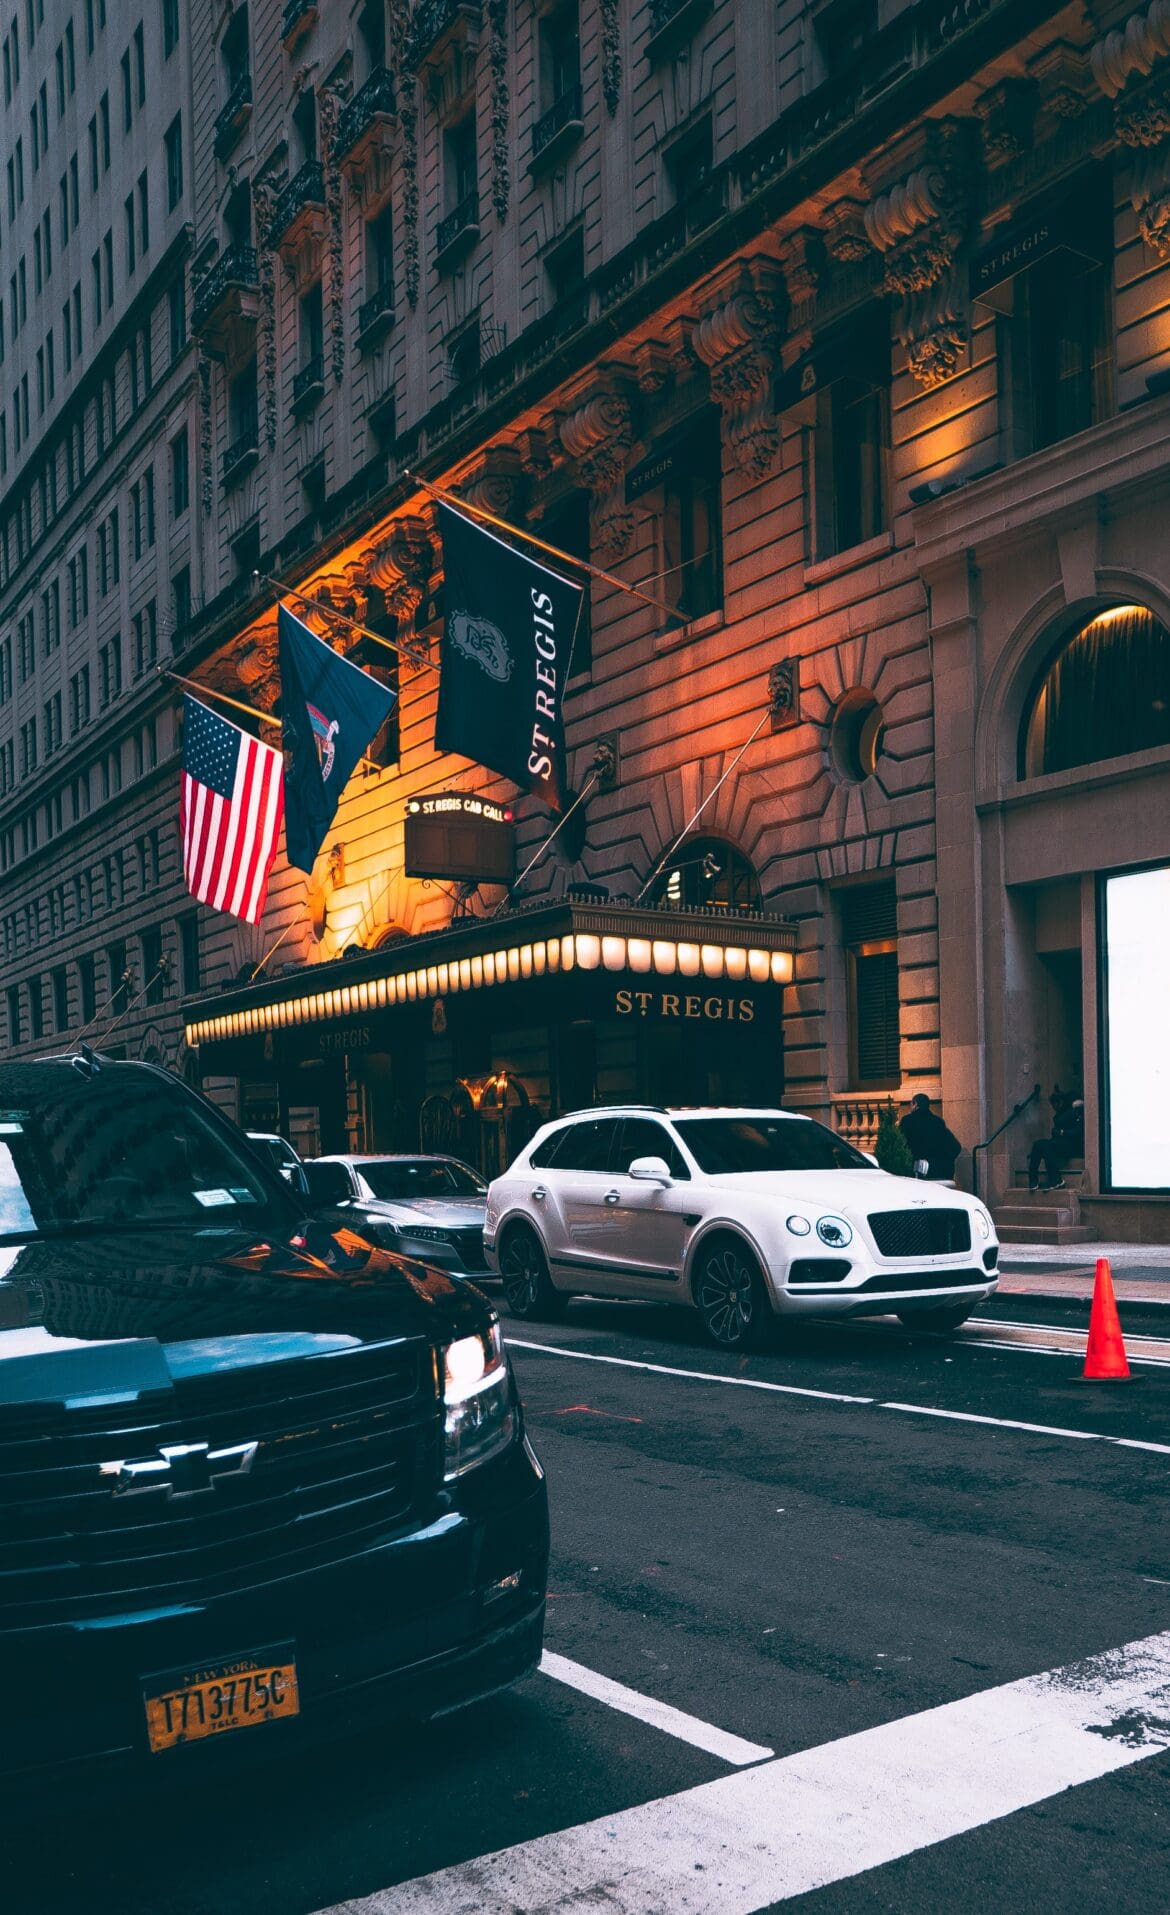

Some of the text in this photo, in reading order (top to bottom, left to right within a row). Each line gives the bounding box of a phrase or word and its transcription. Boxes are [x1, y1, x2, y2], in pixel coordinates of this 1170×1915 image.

[1002, 226, 1049, 266] REGIS
[531, 587, 556, 721] REGIS
[435, 798, 462, 812] REGIS
[463, 799, 482, 814] CAB
[483, 804, 504, 822] CALL
[661, 993, 755, 1022] REGIS
[334, 1027, 369, 1049] REGIS
[223, 1661, 258, 1675] YORK
[160, 1670, 284, 1733] T713775C
